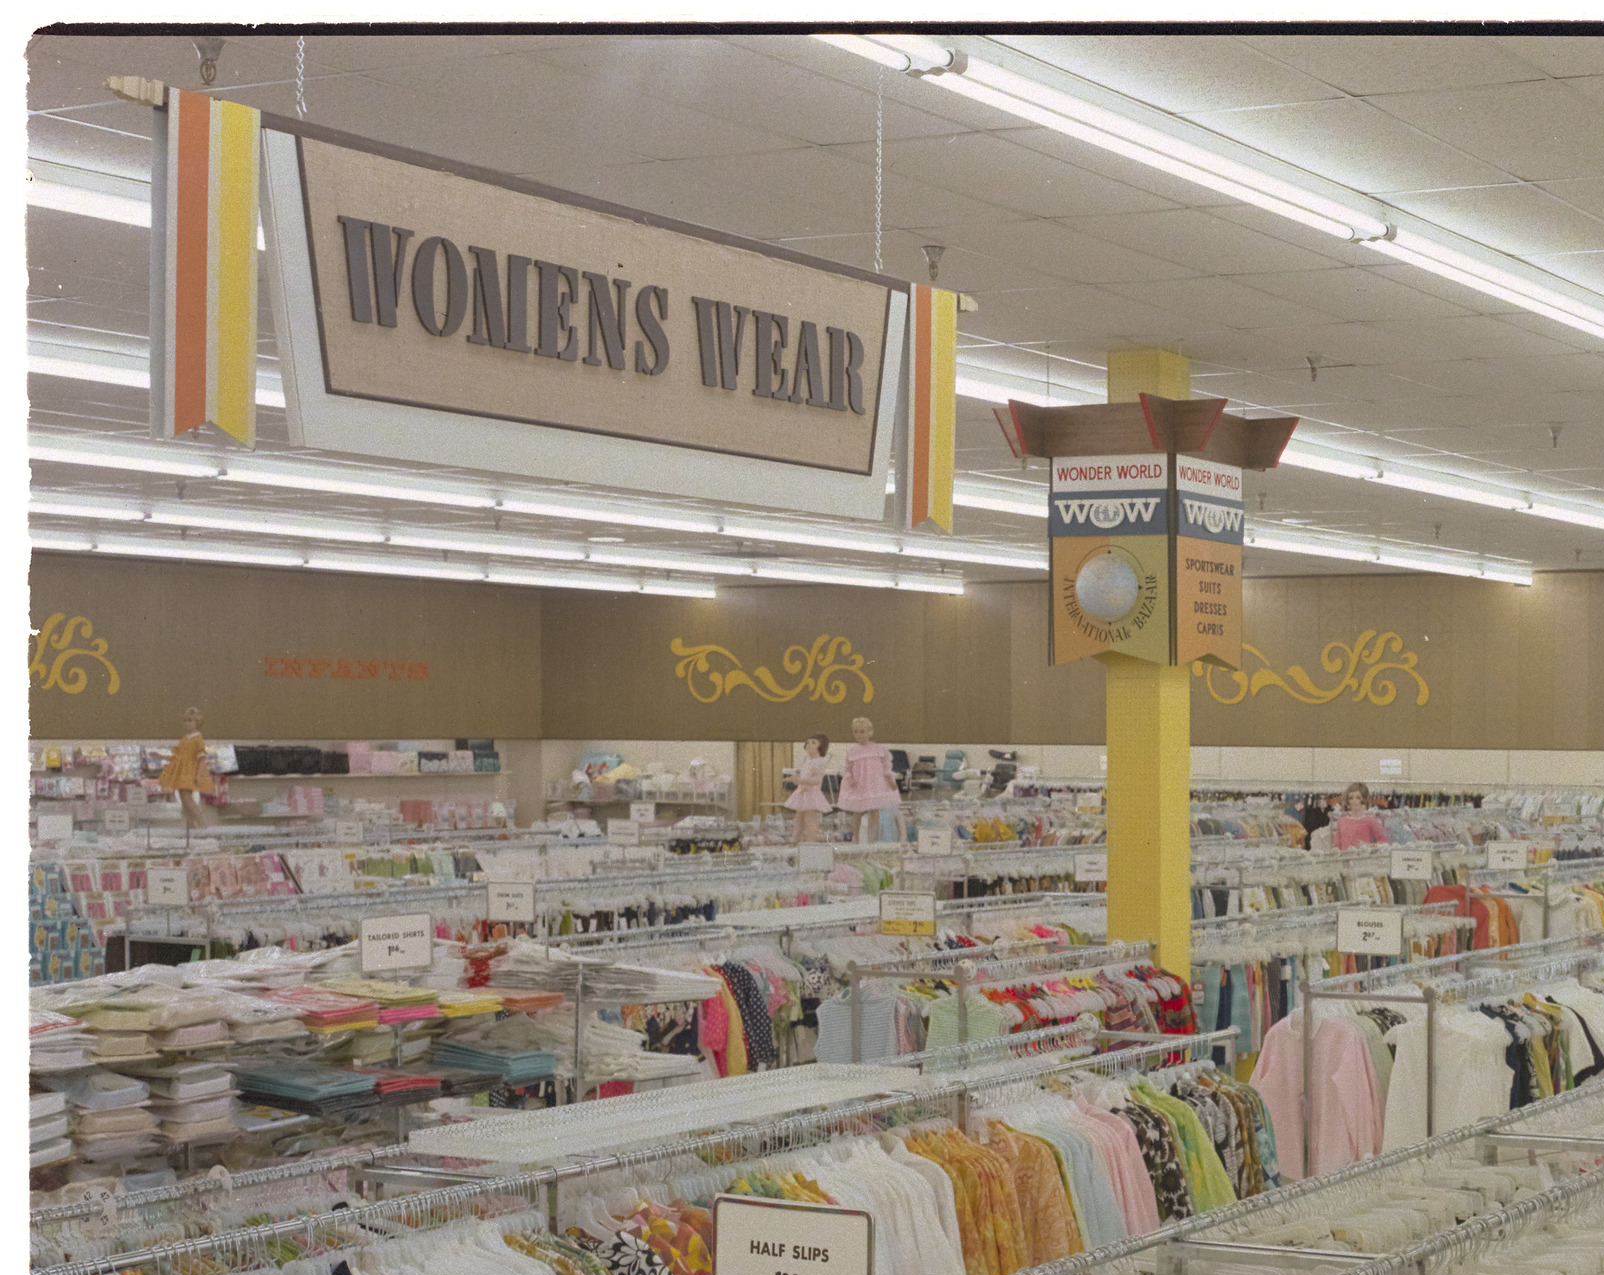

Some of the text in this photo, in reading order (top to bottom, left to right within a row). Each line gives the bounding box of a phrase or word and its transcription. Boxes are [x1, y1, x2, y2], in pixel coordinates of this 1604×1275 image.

[338, 215, 867, 415] WOMENS WEAR
[1057, 464, 1162, 481] WONDER WORLD
[1180, 465, 1240, 490] WONDER WORLD
[1054, 498, 1160, 529] WOW
[1185, 558, 1235, 576] SPORTSWEAR
[1199, 581, 1221, 595] SUITS
[1063, 574, 1158, 643] INTERNATIONAL BAZAAR
[1194, 601, 1227, 616] DRESSES
[1196, 622, 1224, 636] CAPRIS
[367, 930, 425, 942] TAILORED SHIRTS
[750, 1240, 829, 1263] HALF SLIPS
